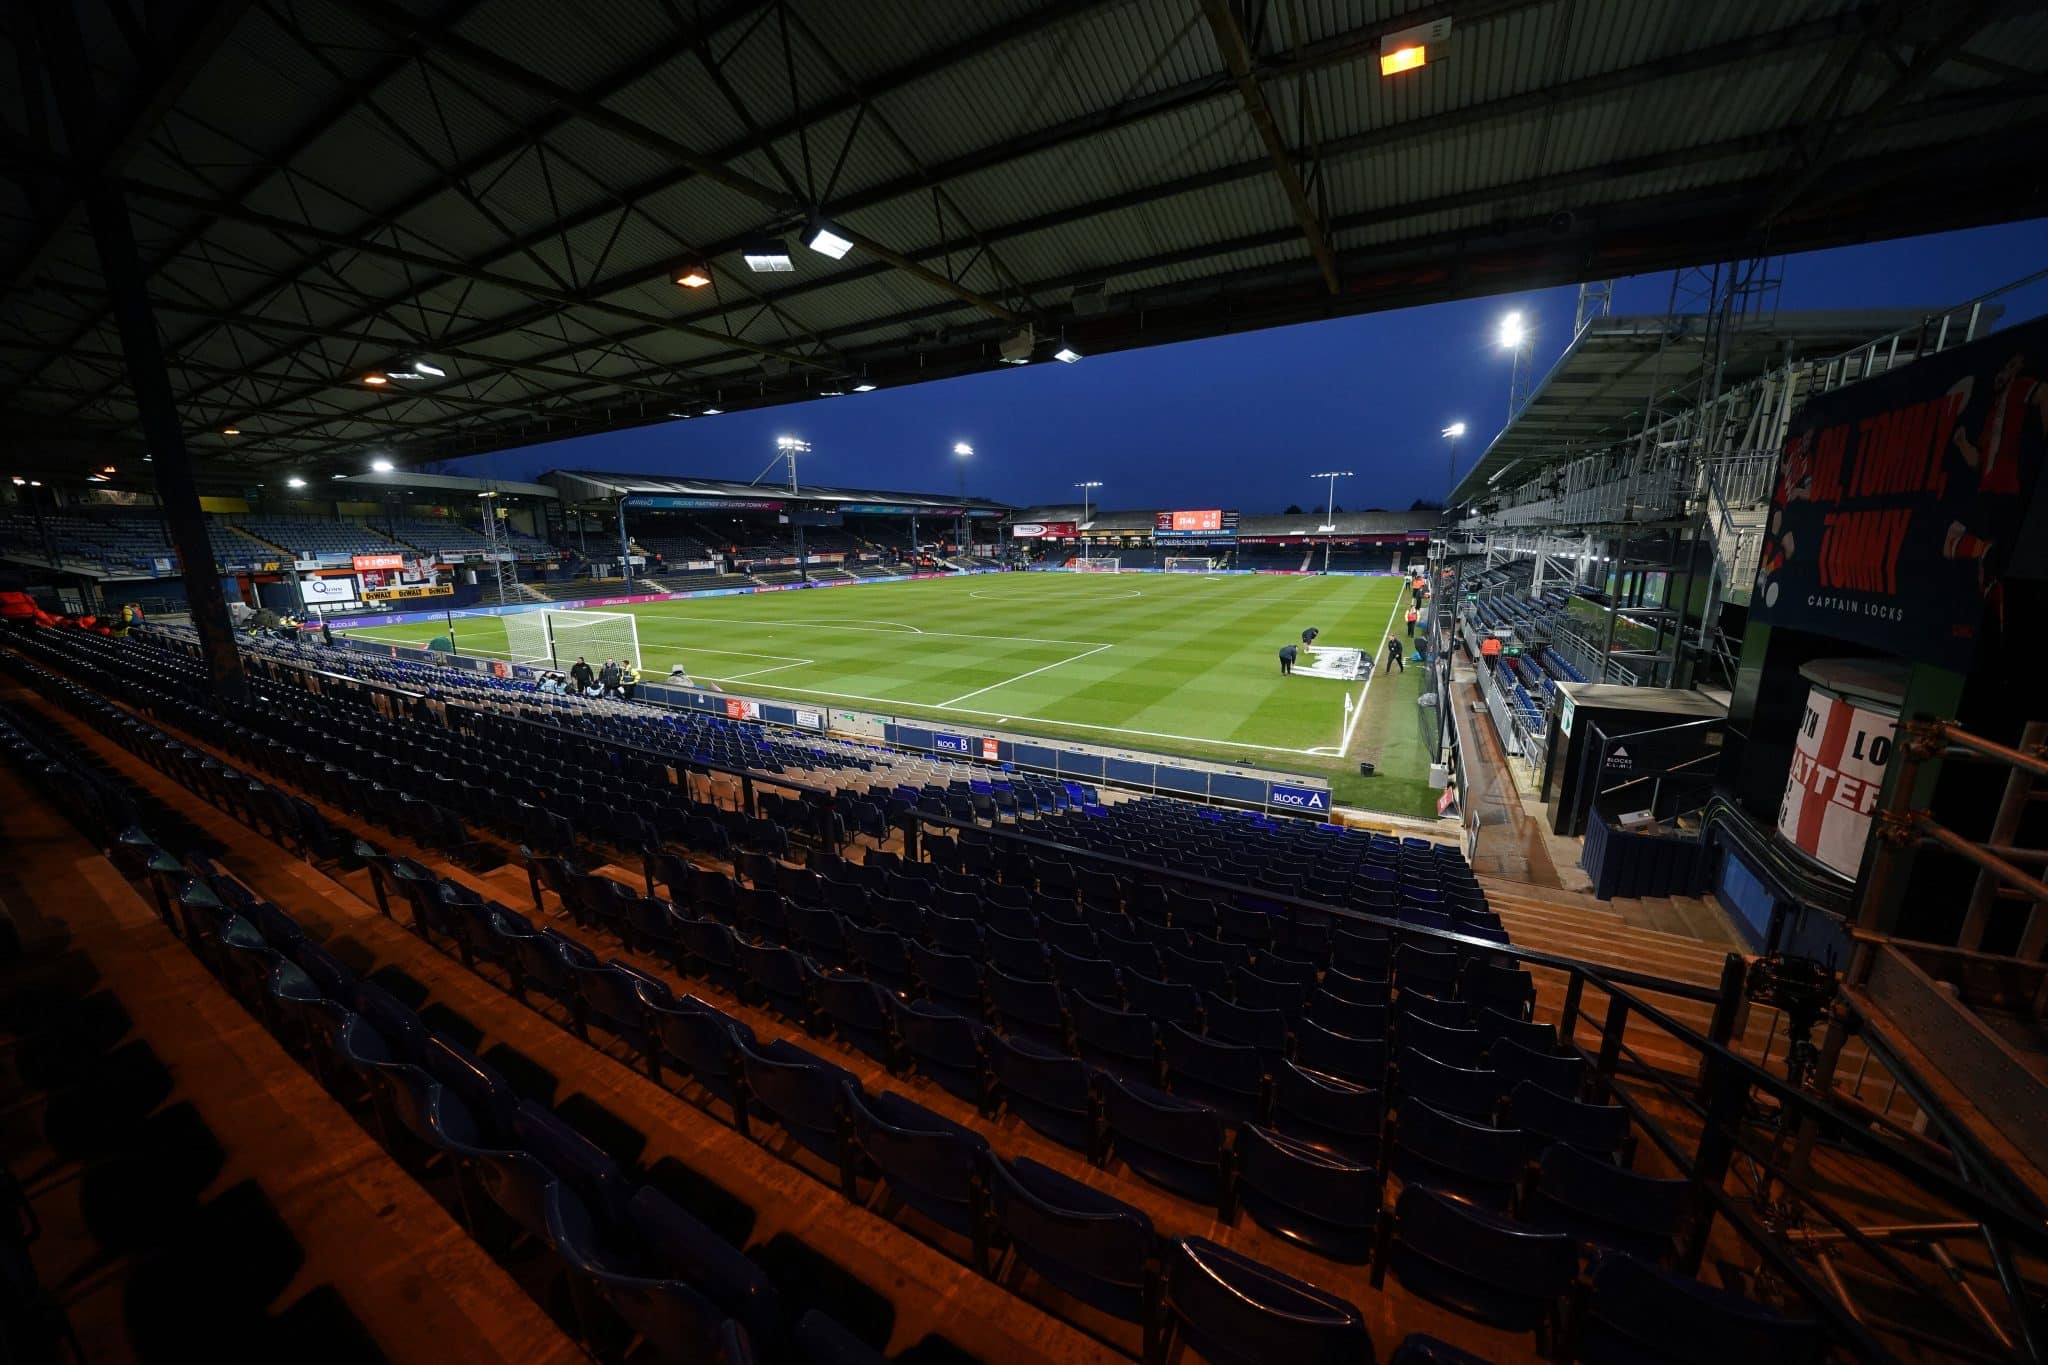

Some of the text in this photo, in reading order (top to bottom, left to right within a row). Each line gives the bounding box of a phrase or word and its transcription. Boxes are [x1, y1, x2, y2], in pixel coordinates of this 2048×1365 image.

[1848, 392, 1964, 501] TOMMY,
[1818, 508, 1913, 595] TOMMY
[1807, 595, 1904, 622] CAPTAIN LOCKS
[937, 739, 968, 750] BLOCK B
[1606, 757, 1632, 765] BLOCKS
[1273, 792, 1322, 808] BLOCK A
